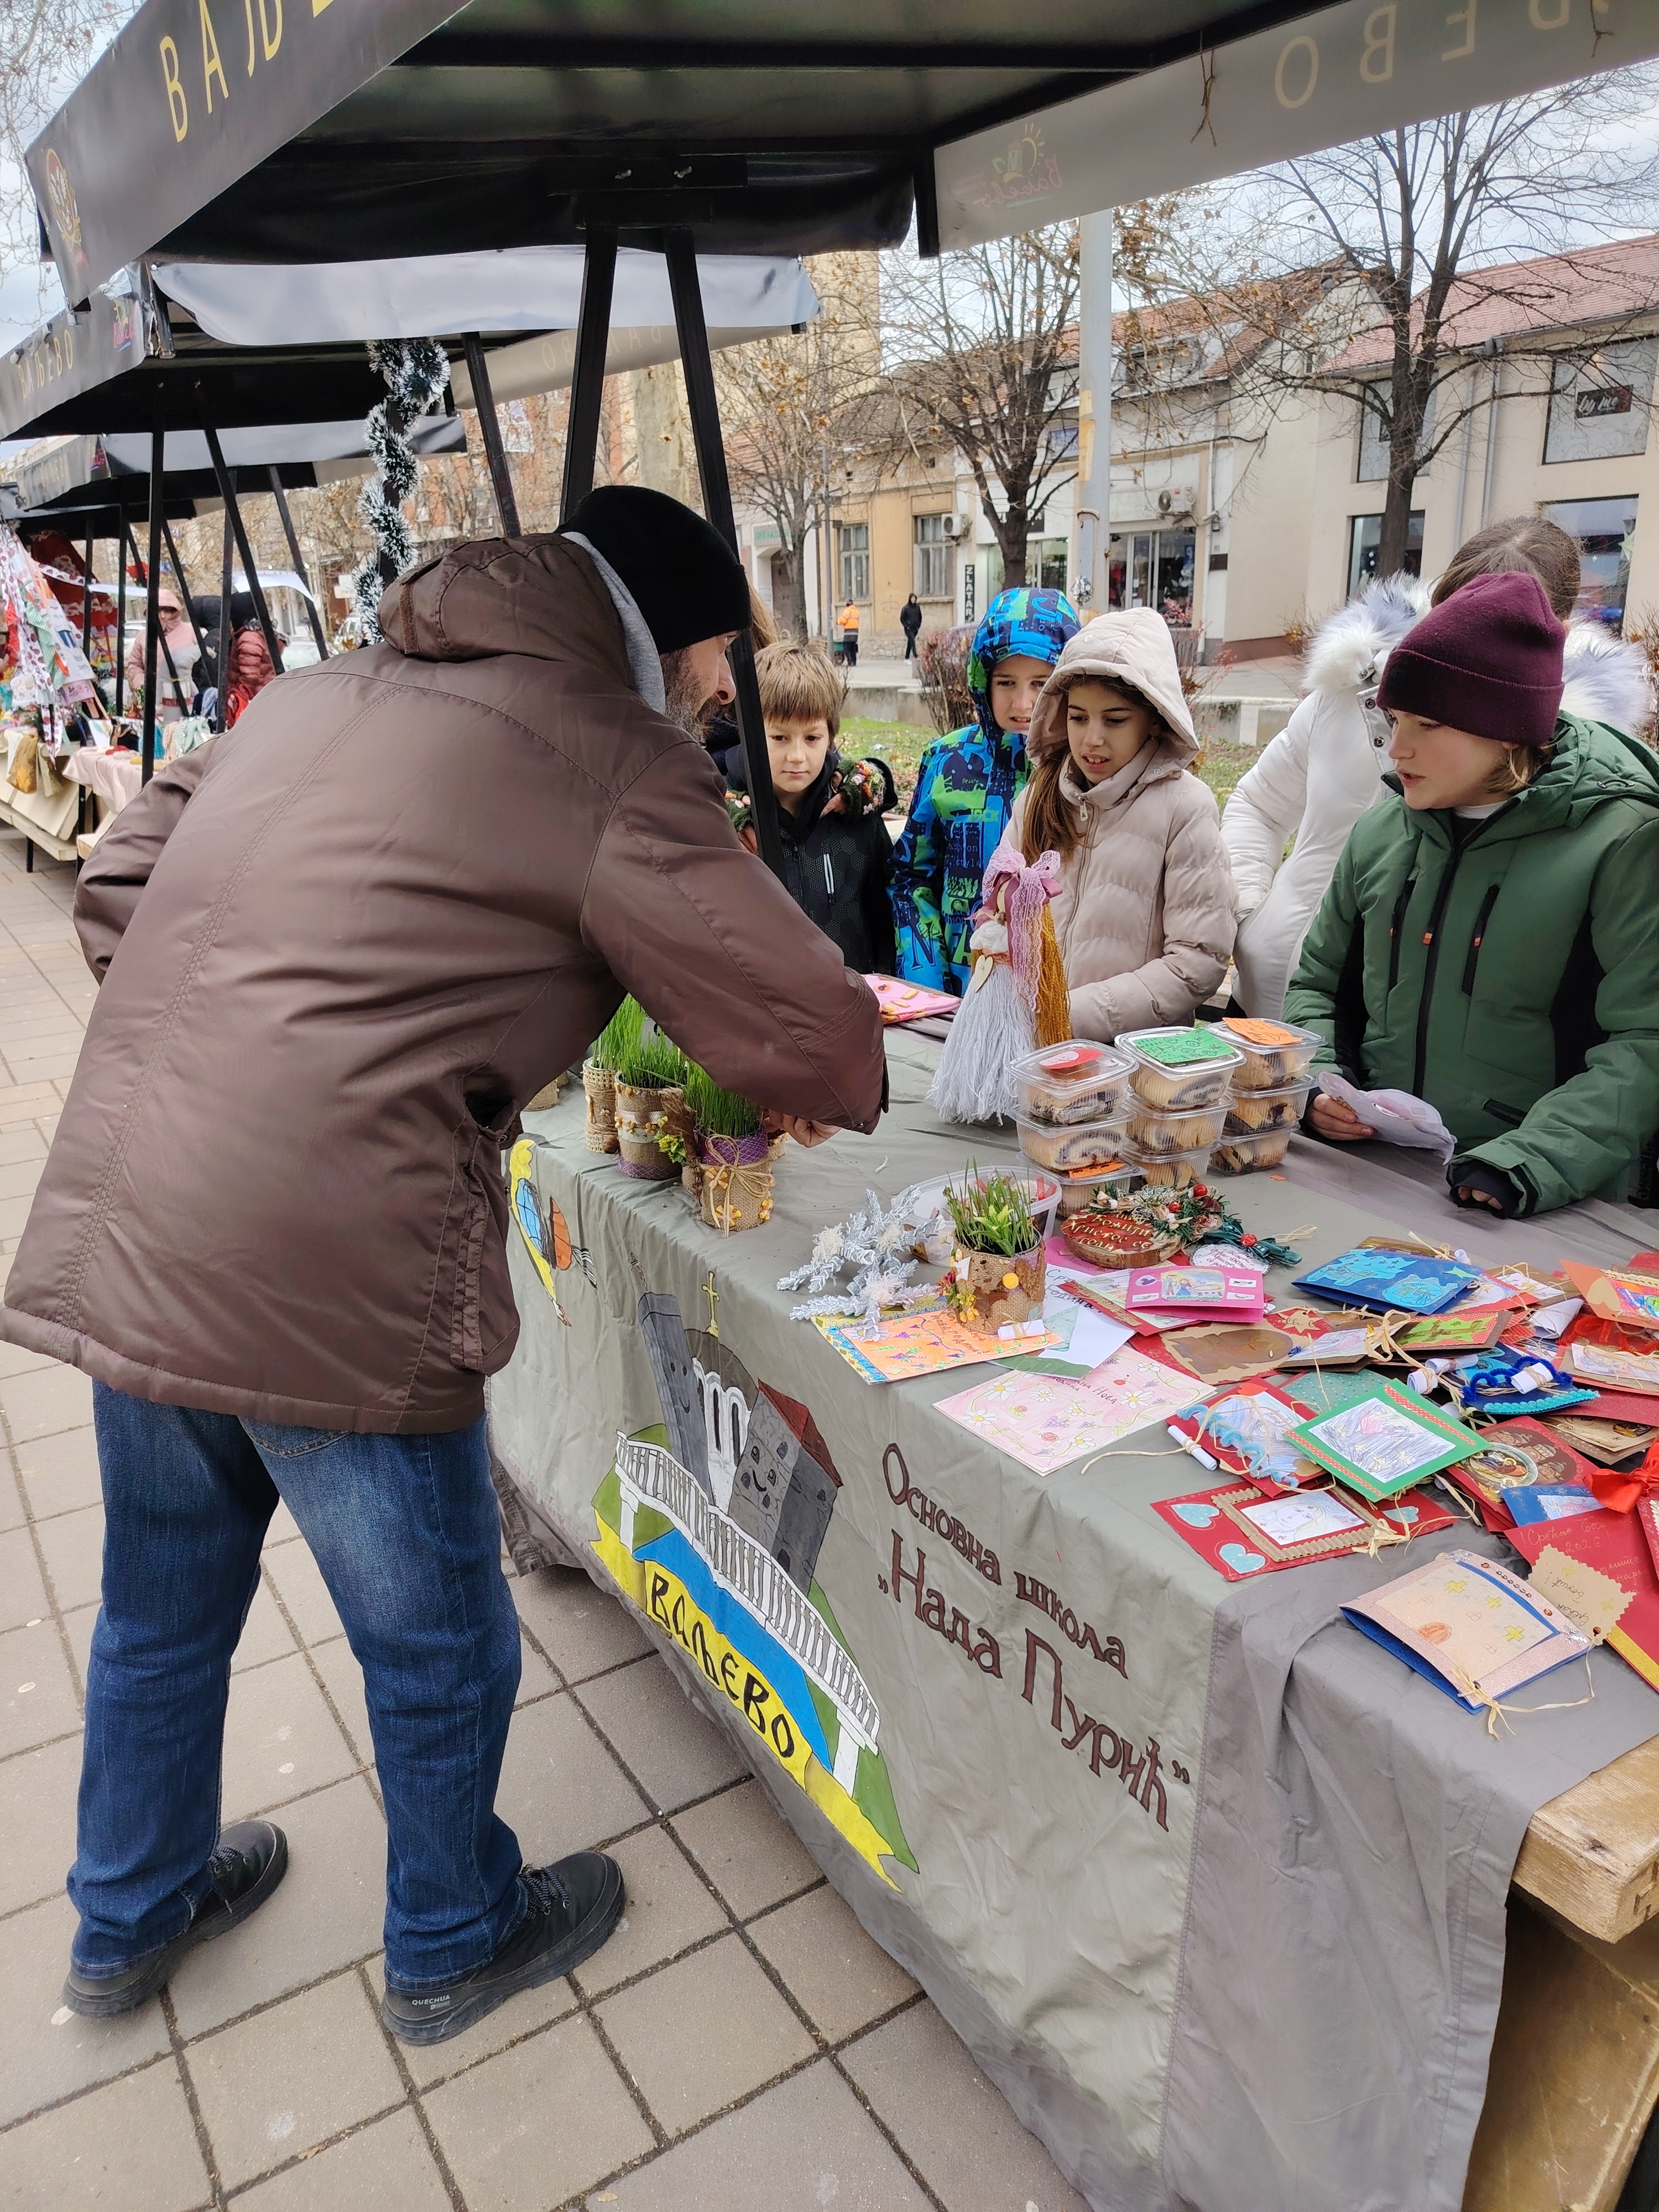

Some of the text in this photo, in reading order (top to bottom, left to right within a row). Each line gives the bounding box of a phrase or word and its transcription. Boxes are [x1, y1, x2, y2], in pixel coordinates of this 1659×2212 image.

[159, 0, 335, 143] ВАЉ
[882, 1442, 1129, 1681] Основна школа
[411, 1994, 451, 2006] QUECHUA
